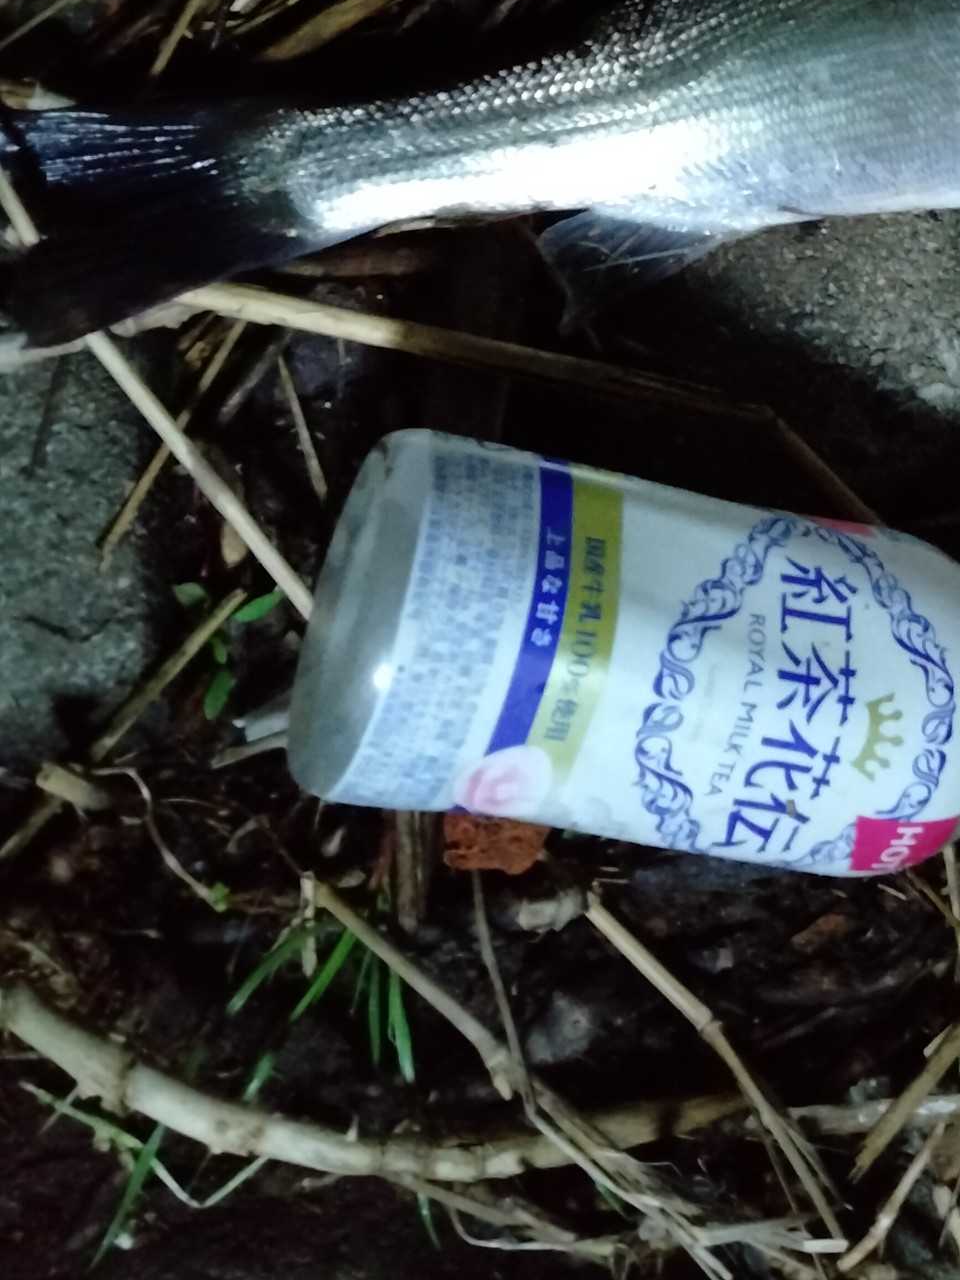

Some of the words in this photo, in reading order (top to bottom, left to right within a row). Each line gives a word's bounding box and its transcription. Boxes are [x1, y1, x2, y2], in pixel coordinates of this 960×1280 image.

[530, 527, 565, 648] 上品な甘さ
[743, 613, 767, 693] ROYAL
[712, 557, 858, 854] 紅茶花伝
[723, 702, 758, 754] MILK
[705, 762, 733, 796] TEA
